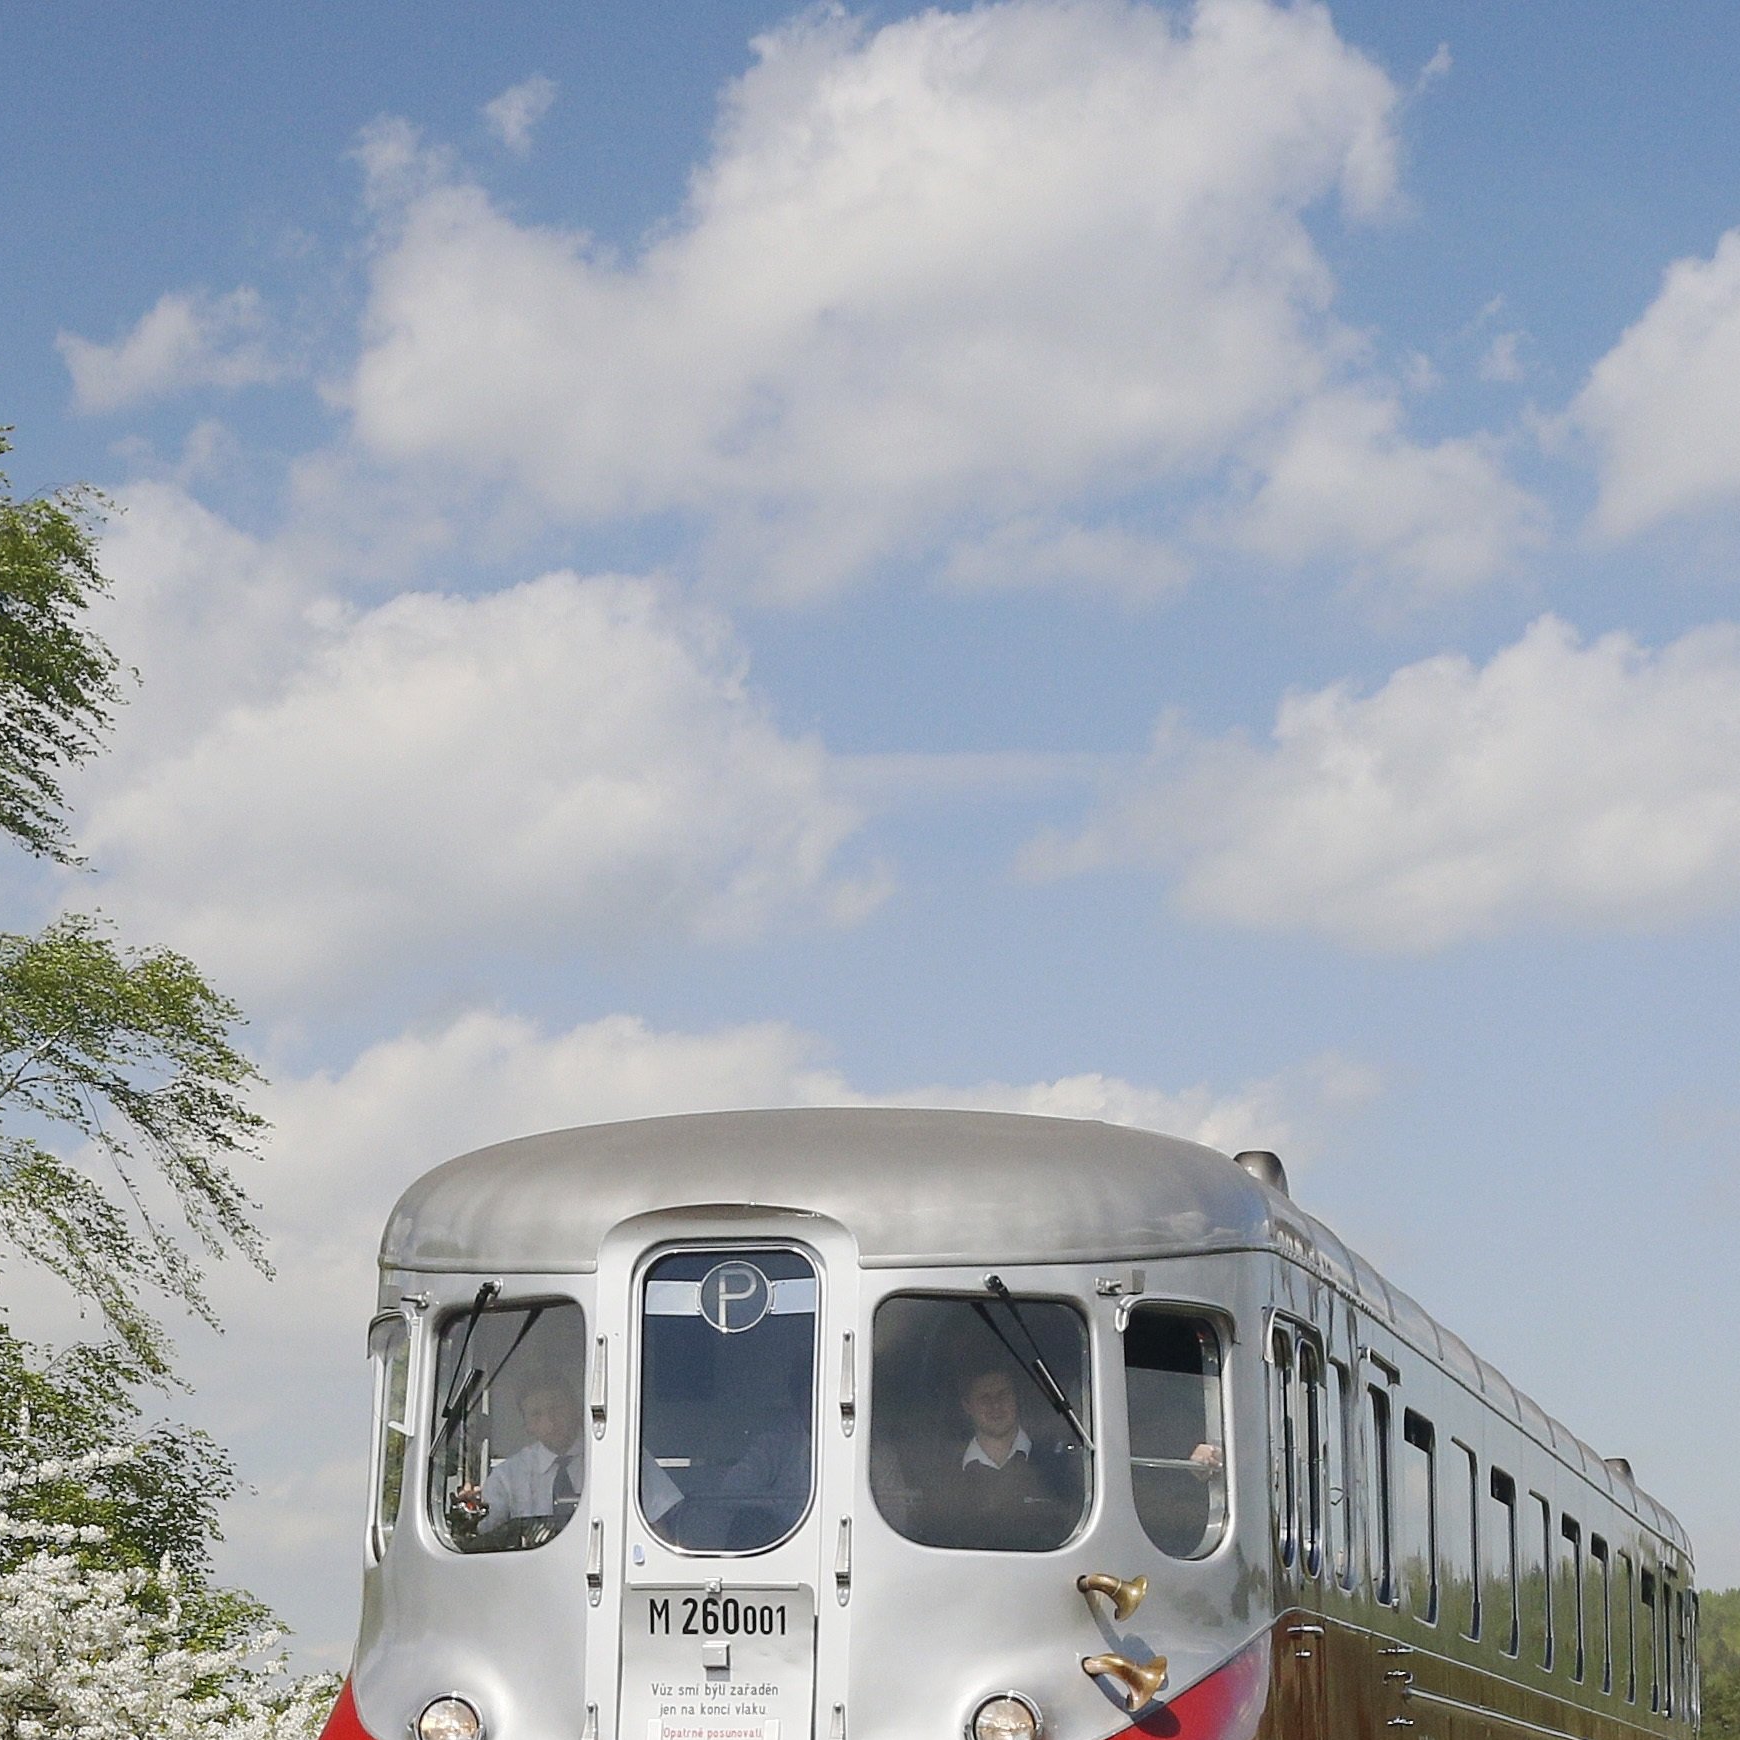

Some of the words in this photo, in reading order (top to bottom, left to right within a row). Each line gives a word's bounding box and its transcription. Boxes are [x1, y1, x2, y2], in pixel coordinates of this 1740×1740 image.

[719, 1268, 757, 1328] P
[649, 1598, 670, 1634] M
[730, 1683, 779, 1696] zařaděn
[660, 1703, 677, 1717] jen
[681, 1706, 695, 1715] na
